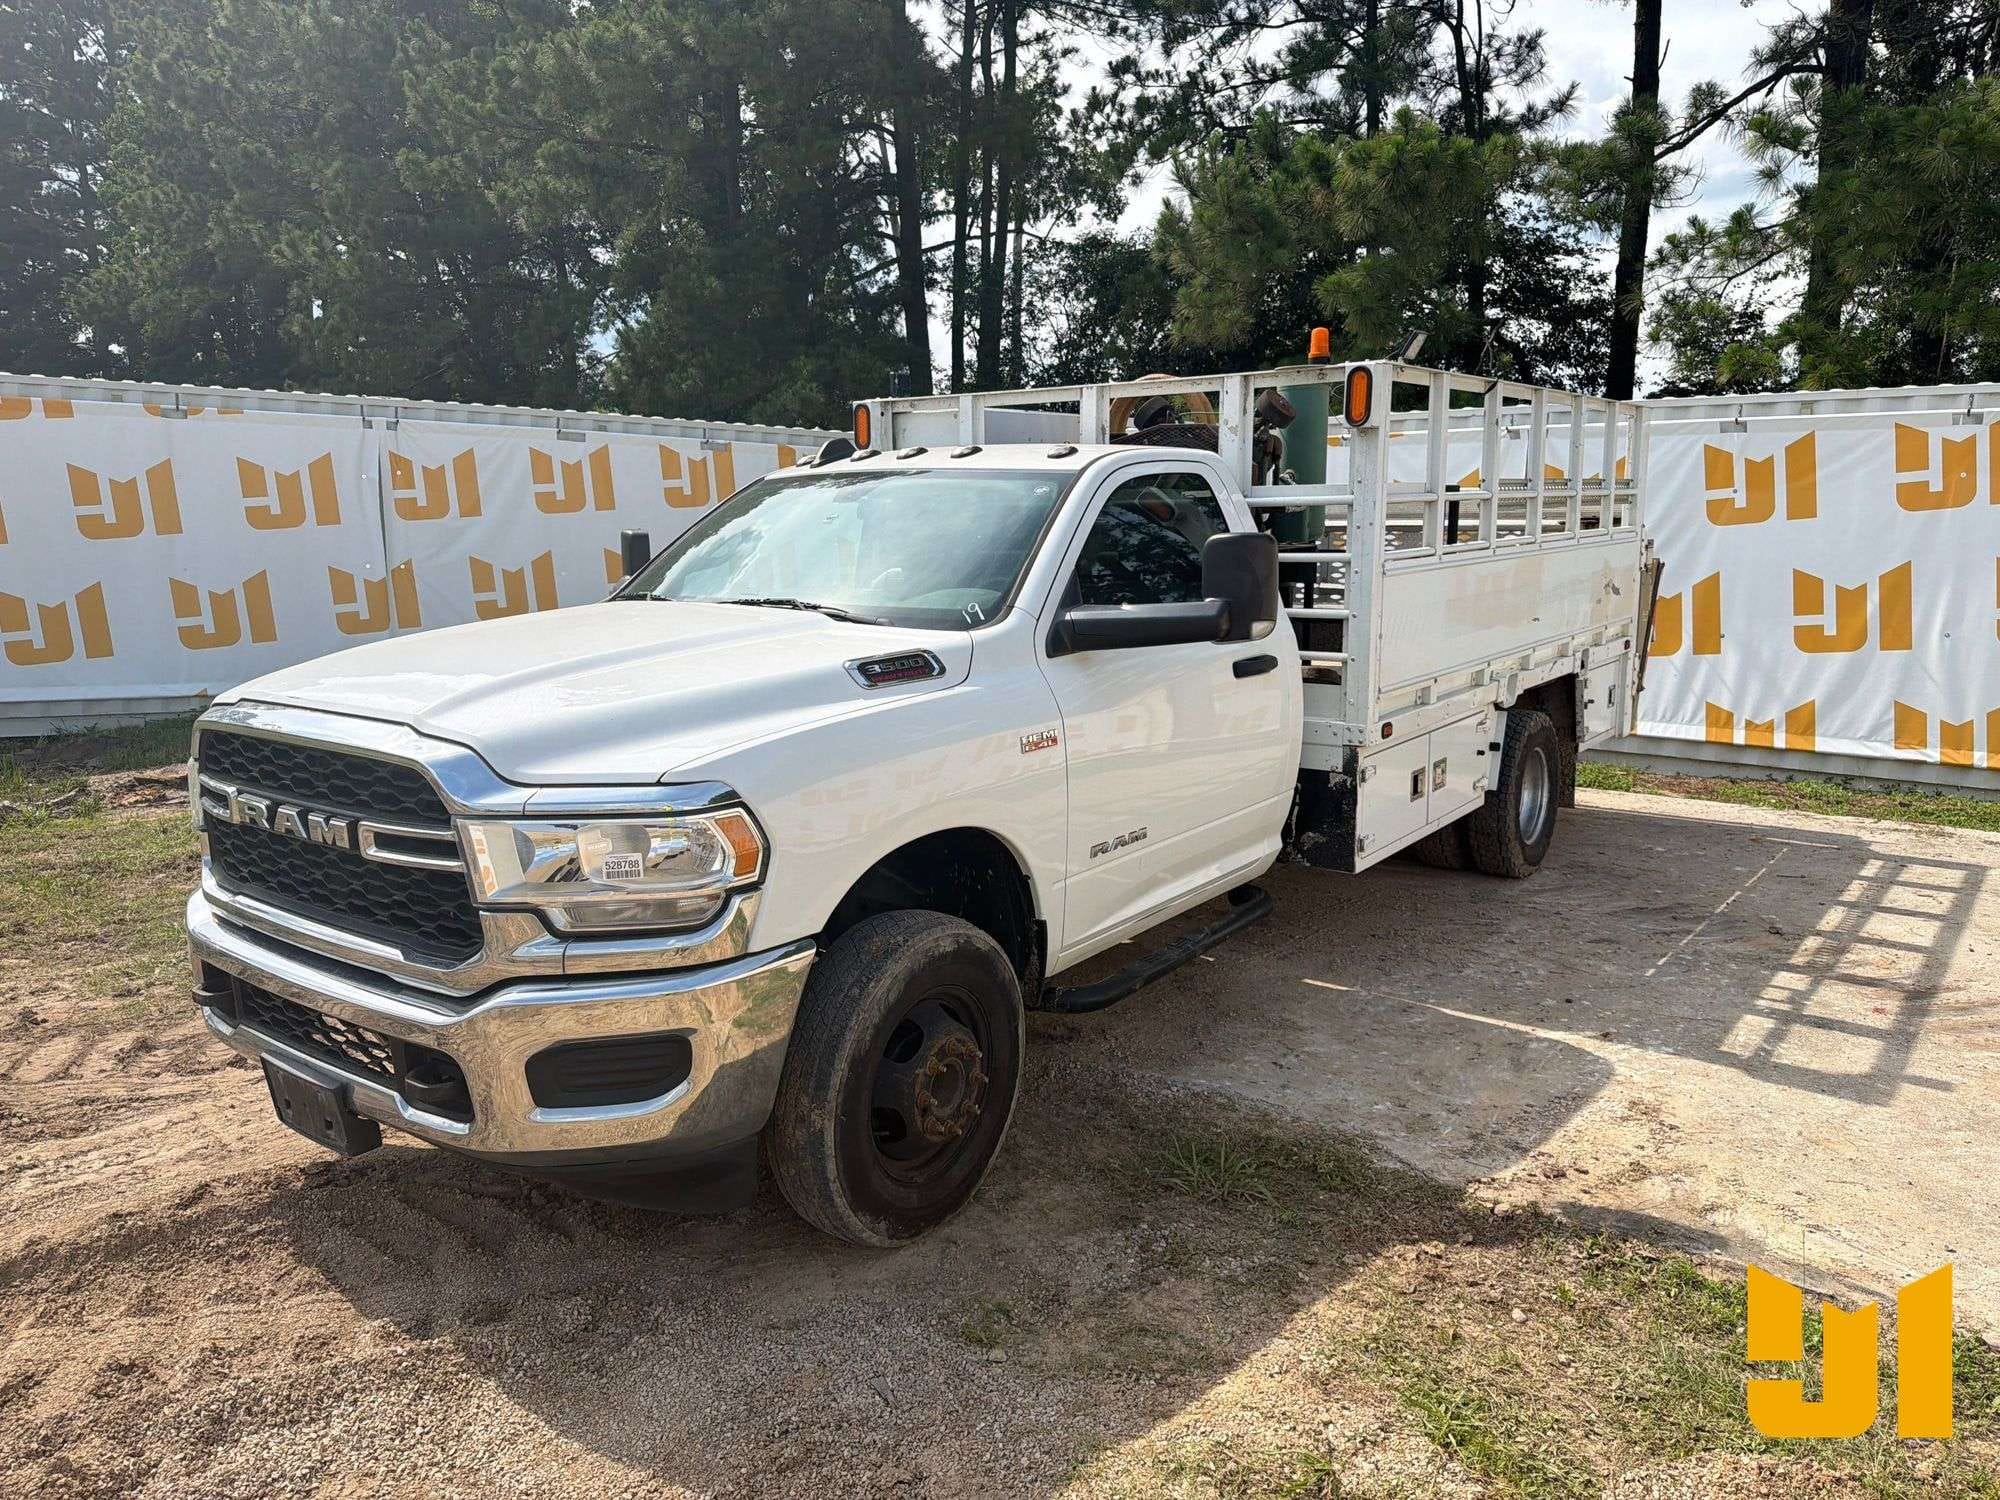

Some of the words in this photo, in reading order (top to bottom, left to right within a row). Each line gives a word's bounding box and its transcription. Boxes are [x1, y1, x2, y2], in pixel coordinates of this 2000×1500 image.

[962, 602, 985, 624] 19
[864, 659, 924, 674] 3500
[1021, 728, 1057, 745] HEMI
[237, 793, 352, 850] RAM
[1090, 826, 1148, 858] RAM
[605, 860, 640, 870] 528788
